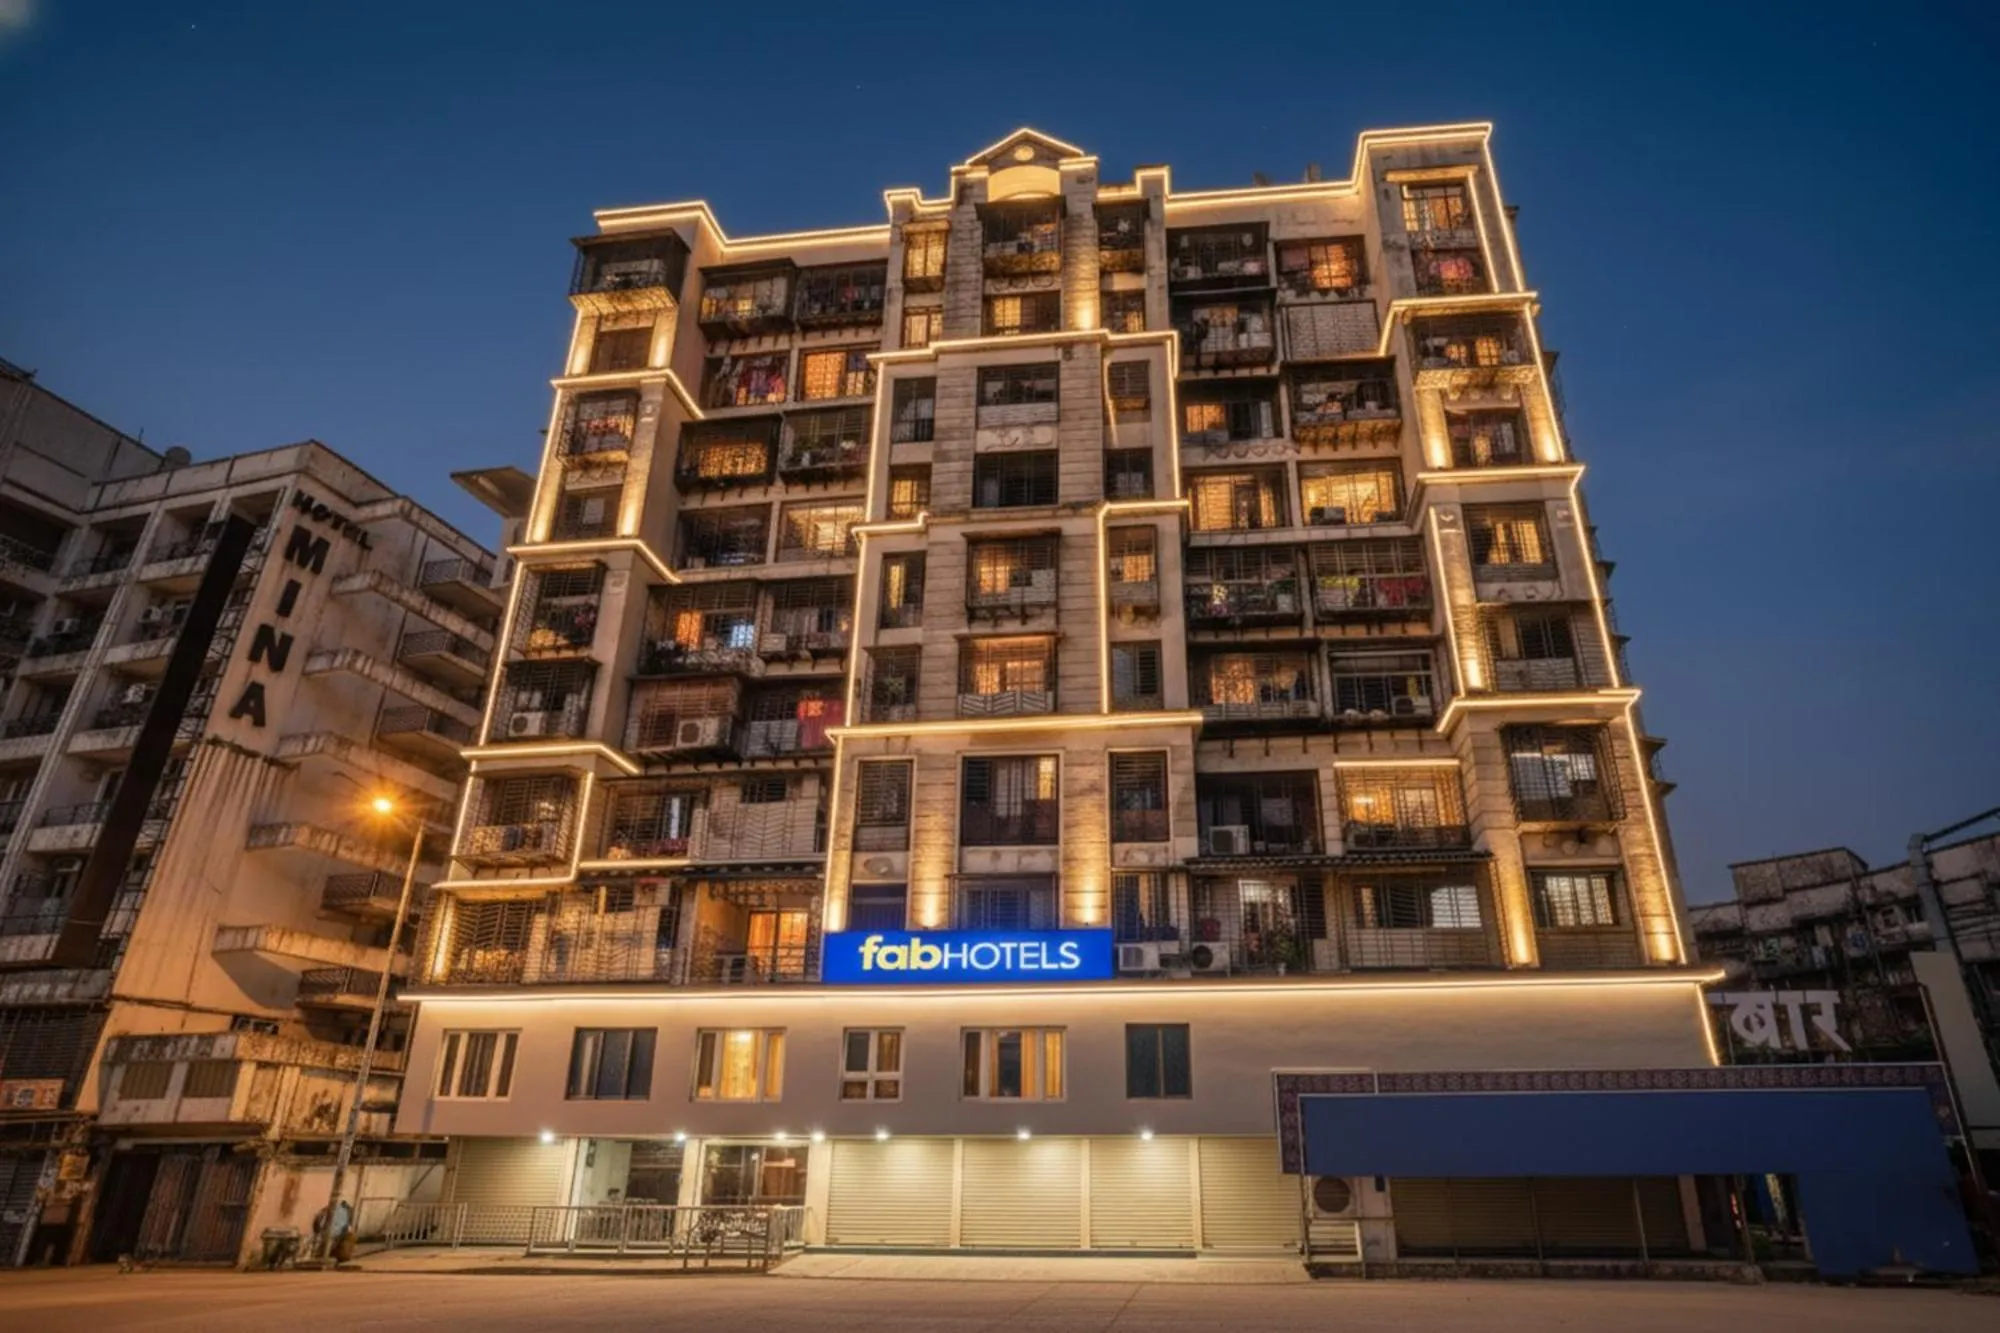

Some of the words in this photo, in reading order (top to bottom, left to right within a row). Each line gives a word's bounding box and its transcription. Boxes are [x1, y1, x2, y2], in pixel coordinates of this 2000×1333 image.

[291, 489, 373, 551] HOTEL
[228, 525, 331, 728] MINA
[858, 935, 1081, 971] fabHOTELS
